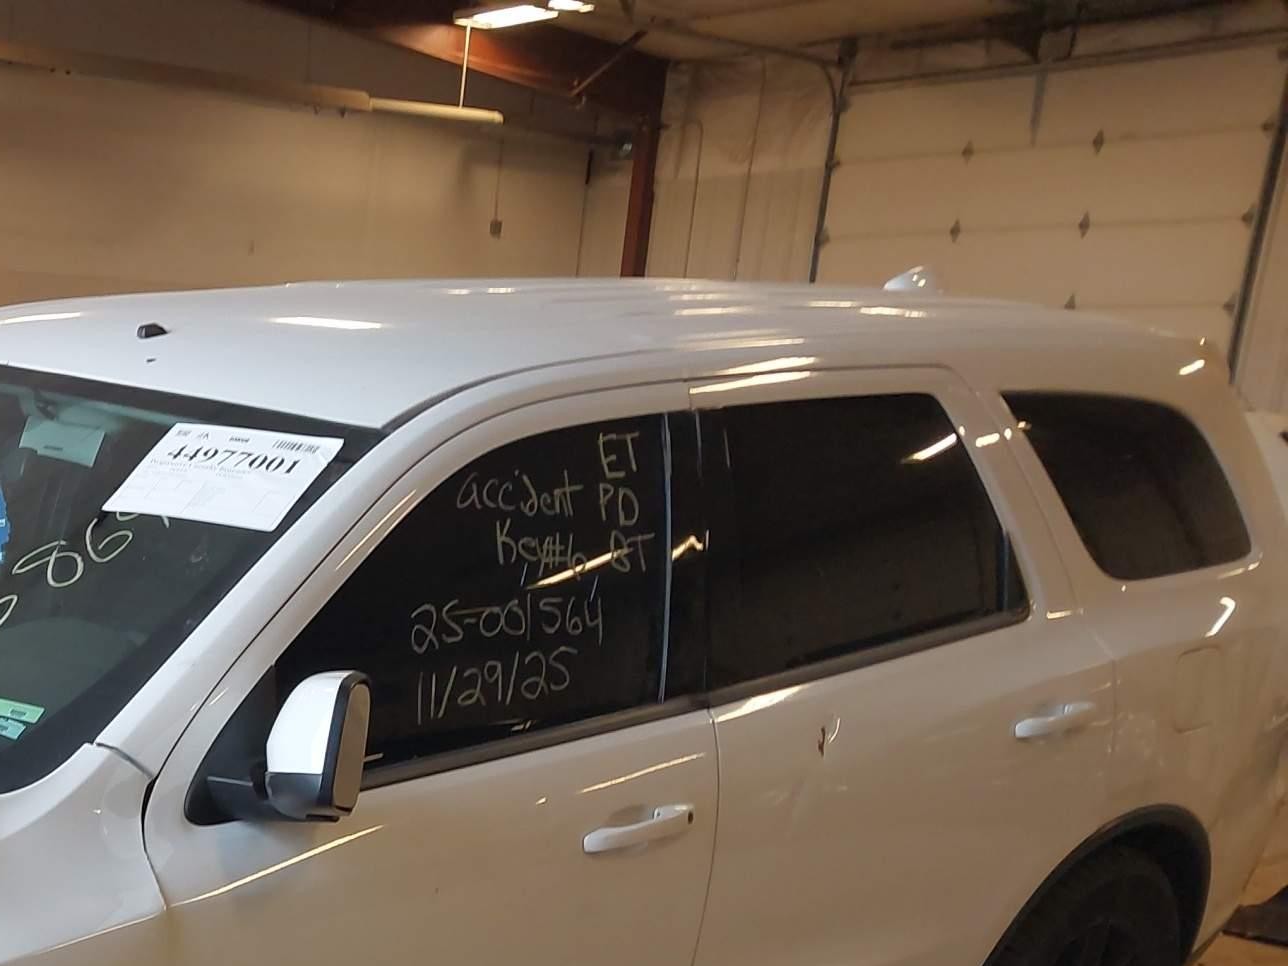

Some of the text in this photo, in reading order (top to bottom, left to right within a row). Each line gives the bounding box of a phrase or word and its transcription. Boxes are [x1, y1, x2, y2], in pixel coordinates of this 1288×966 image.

[168, 444, 301, 475] 44977001
[597, 432, 639, 479] ET
[599, 483, 639, 526] PD
[417, 646, 578, 725] 11/29/25
